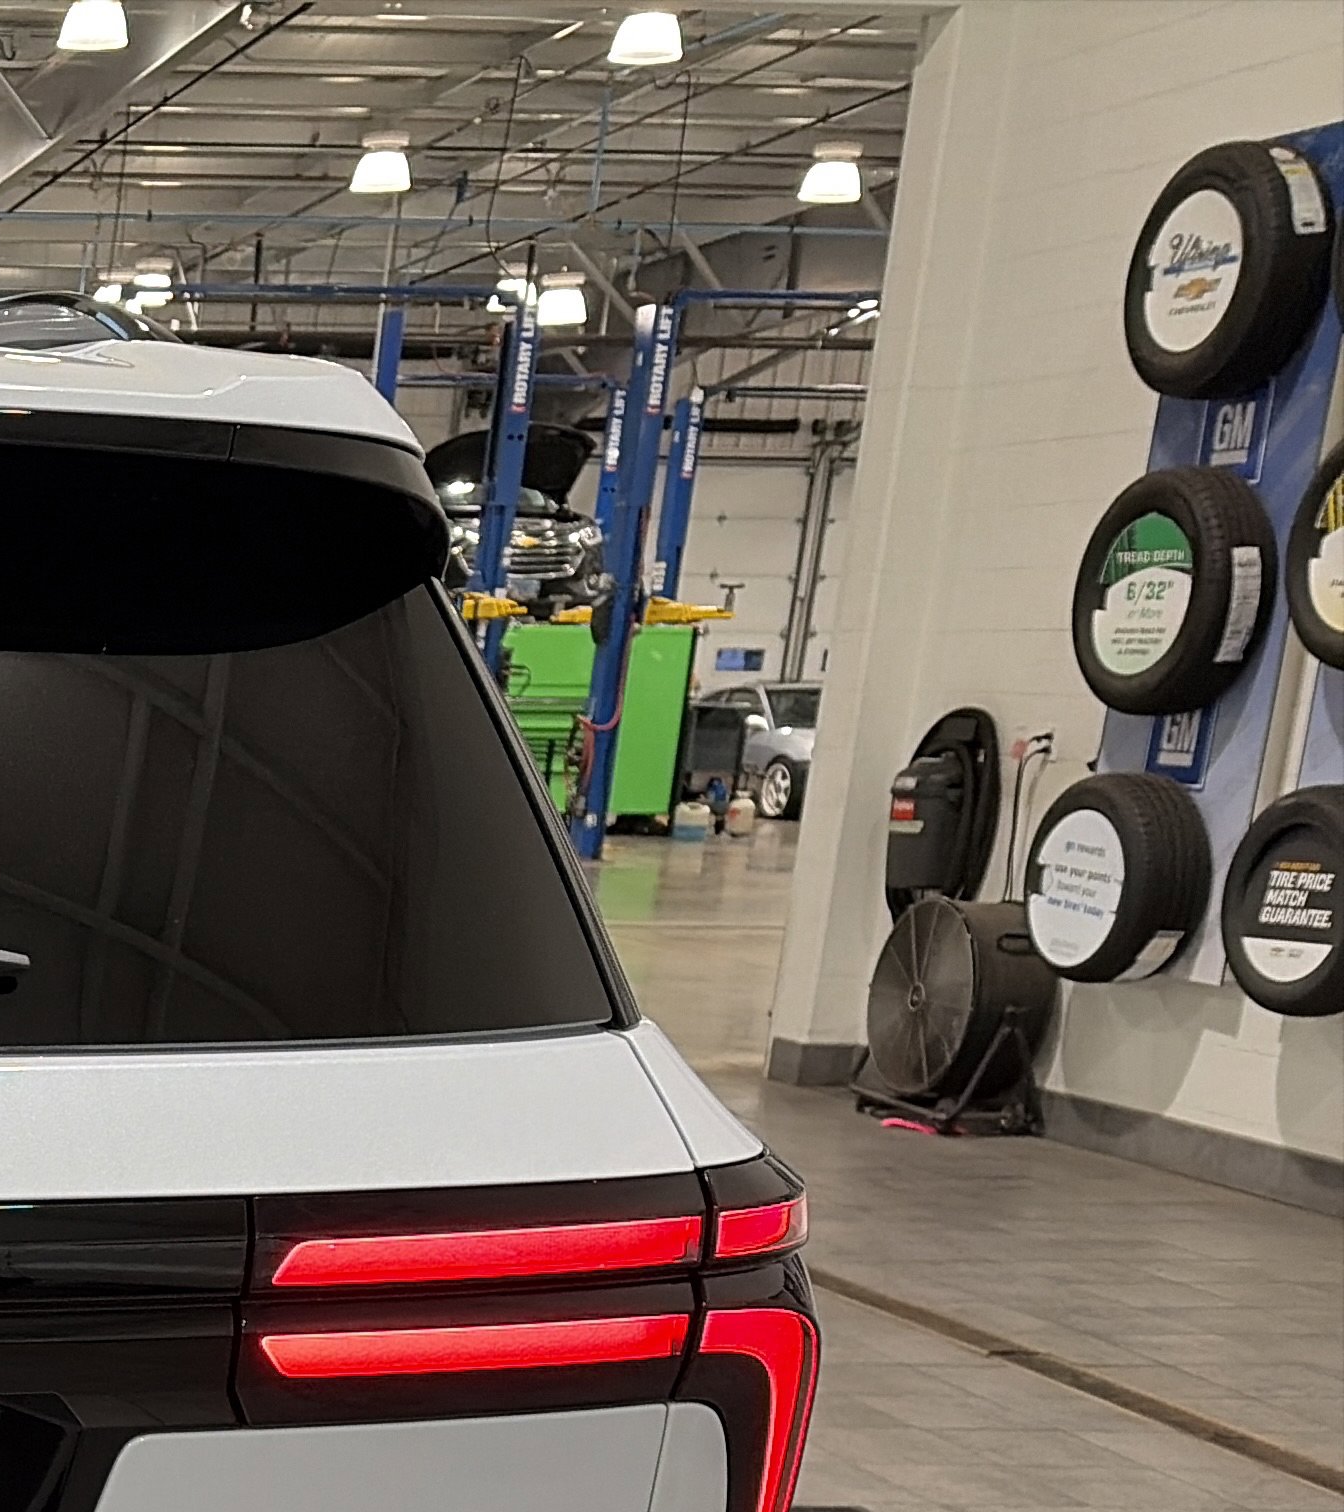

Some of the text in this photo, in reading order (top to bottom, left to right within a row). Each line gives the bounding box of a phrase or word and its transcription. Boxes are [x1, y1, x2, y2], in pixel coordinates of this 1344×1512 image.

[512, 305, 538, 404] ROTARY LIFT
[647, 304, 674, 406] ROTARY LIFT
[606, 389, 627, 466] ROTARY LIFT
[683, 425, 699, 471] ROTARY
[1213, 401, 1256, 451] GM
[1117, 549, 1185, 564] TREAD DEPTH
[1264, 888, 1309, 907] MATCH
[1269, 870, 1336, 893] TIRE PRICE
[1258, 906, 1333, 929] GUARANTEE.
